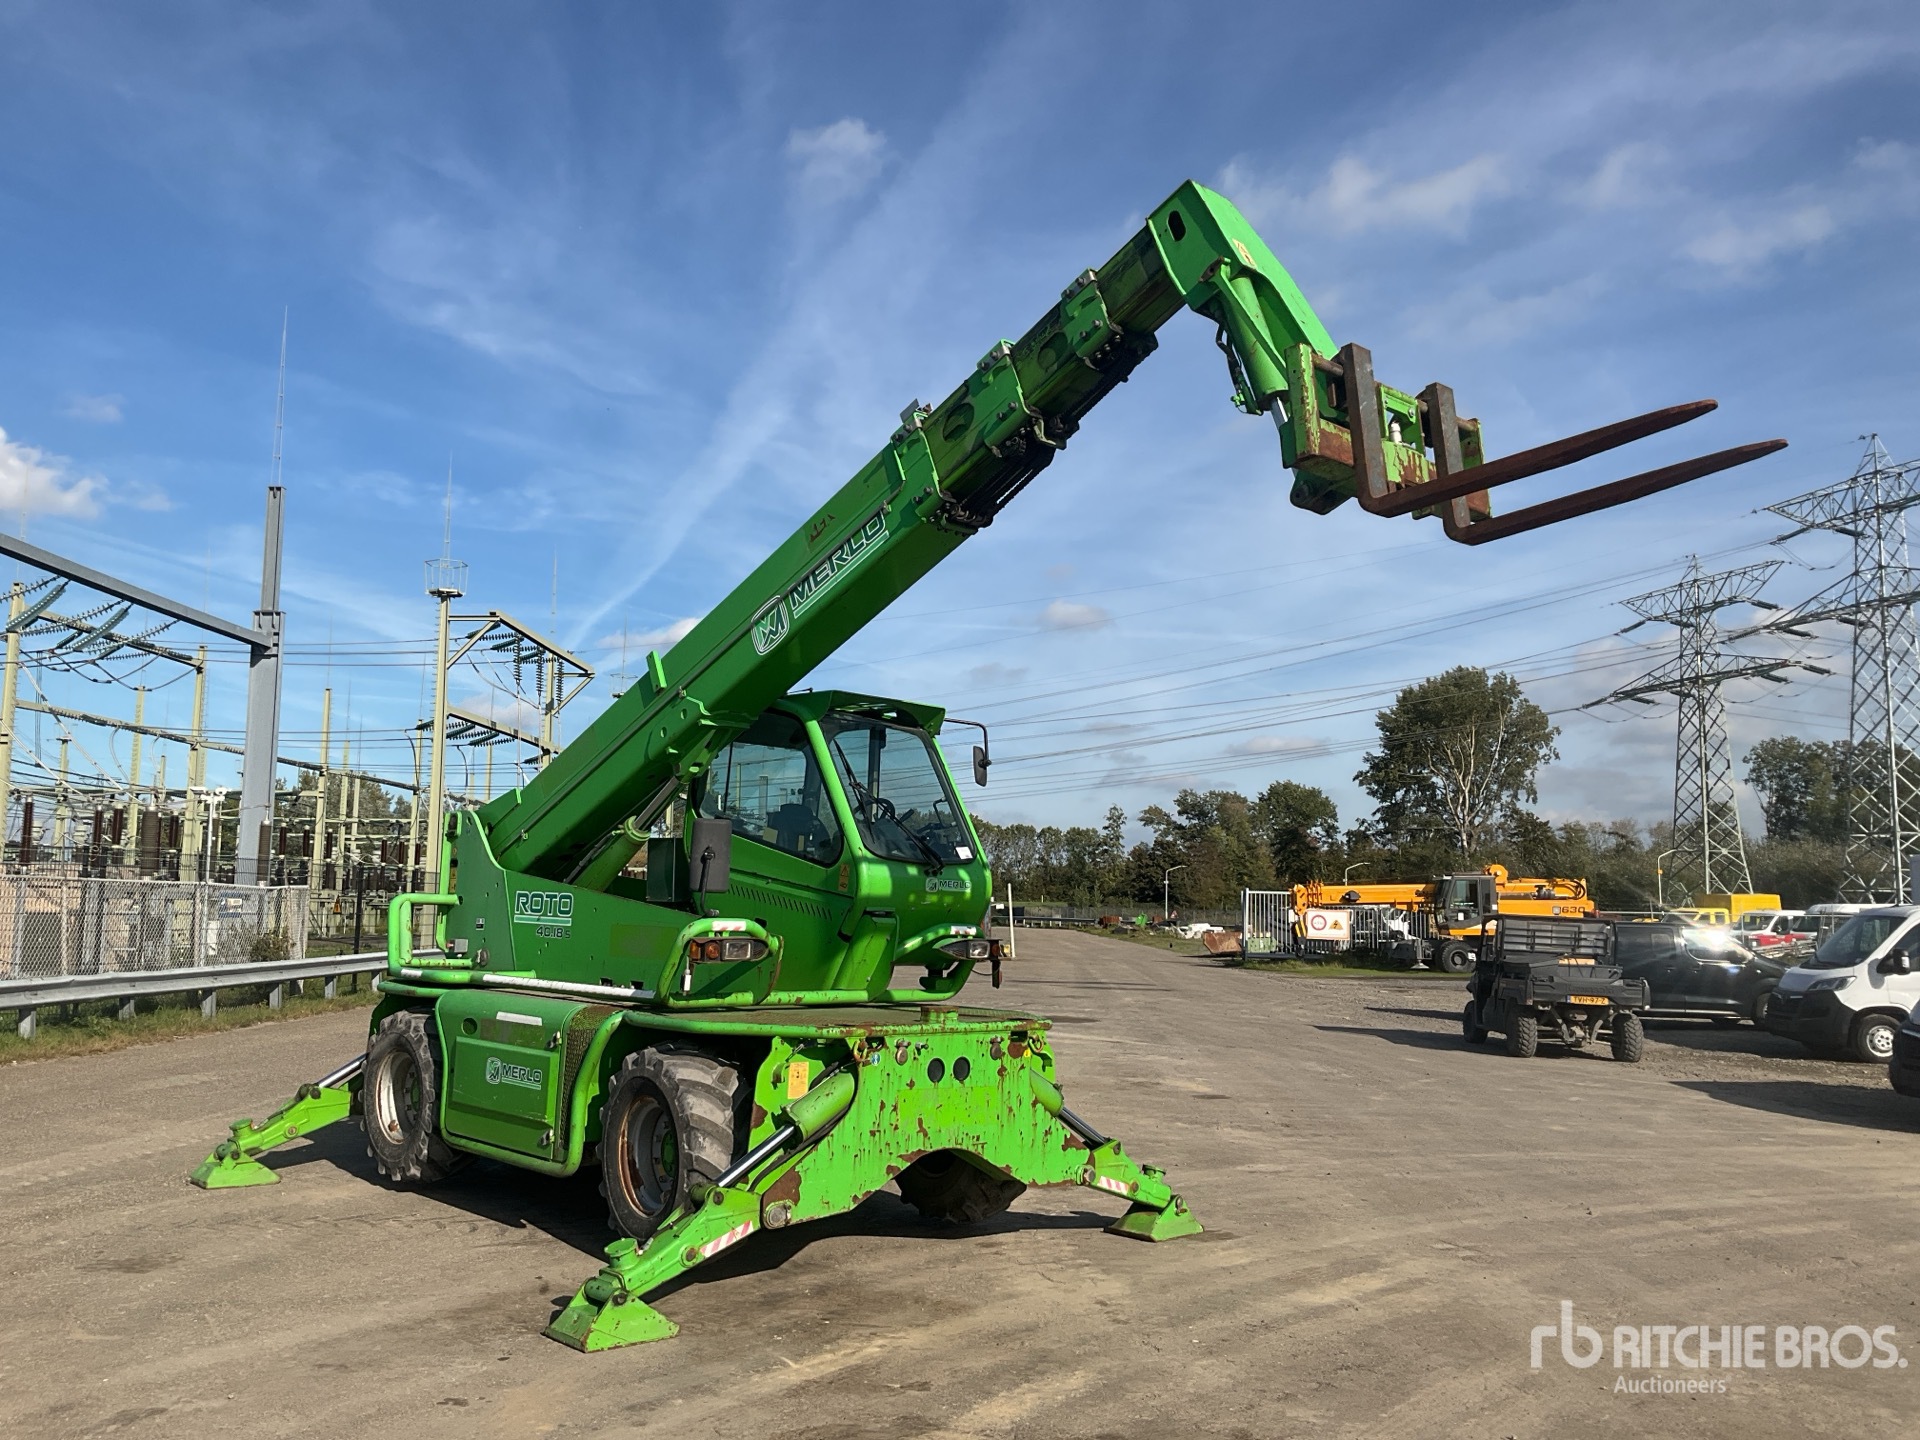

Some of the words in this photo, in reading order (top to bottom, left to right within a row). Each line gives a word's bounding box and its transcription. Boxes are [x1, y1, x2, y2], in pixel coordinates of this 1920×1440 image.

[788, 511, 887, 610] MERLO
[940, 880, 972, 890] MERLO
[514, 890, 574, 917] ROTO
[1561, 906, 1586, 914] 630
[536, 926, 564, 939] 40.18
[502, 1063, 543, 1085] MERLO
